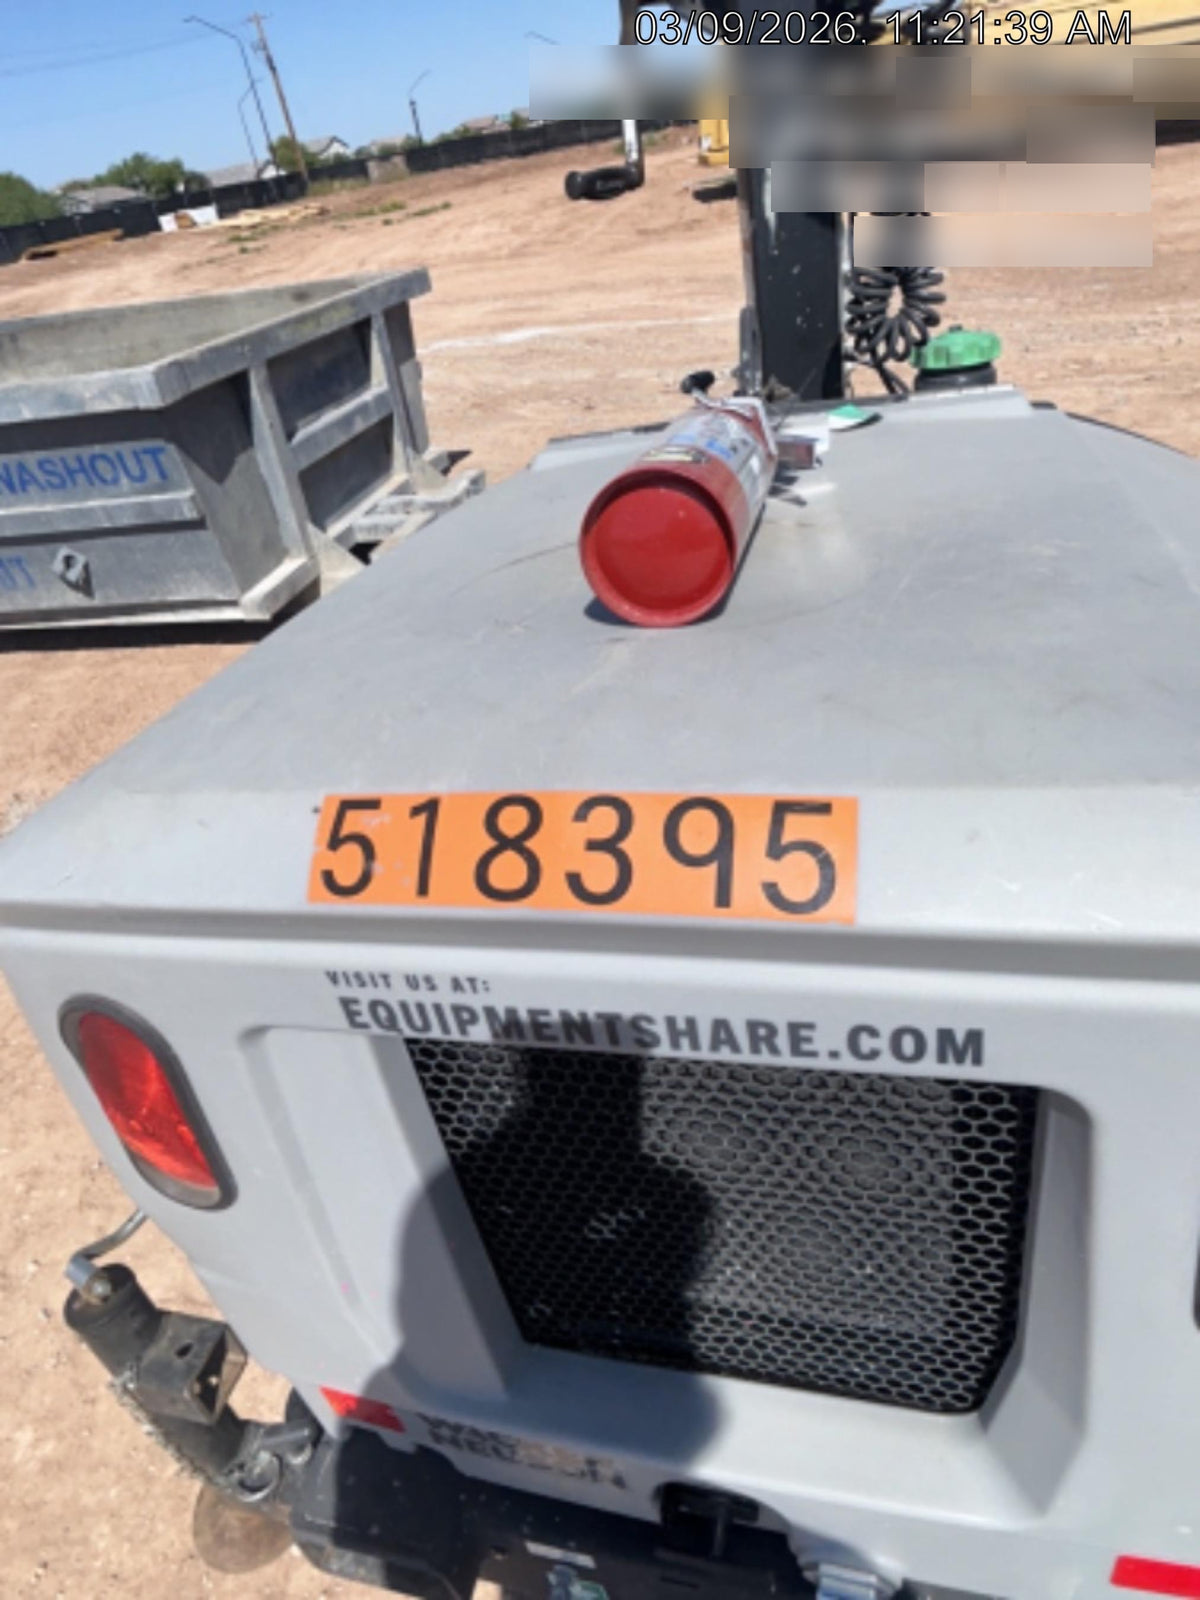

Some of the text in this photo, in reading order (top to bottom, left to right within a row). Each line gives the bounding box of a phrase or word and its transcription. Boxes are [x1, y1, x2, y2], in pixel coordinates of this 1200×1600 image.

[320, 794, 837, 915] 518395
[325, 970, 490, 994] VISIT US AT:
[338, 996, 984, 1067] EQUIPMENTSHARE.COM
